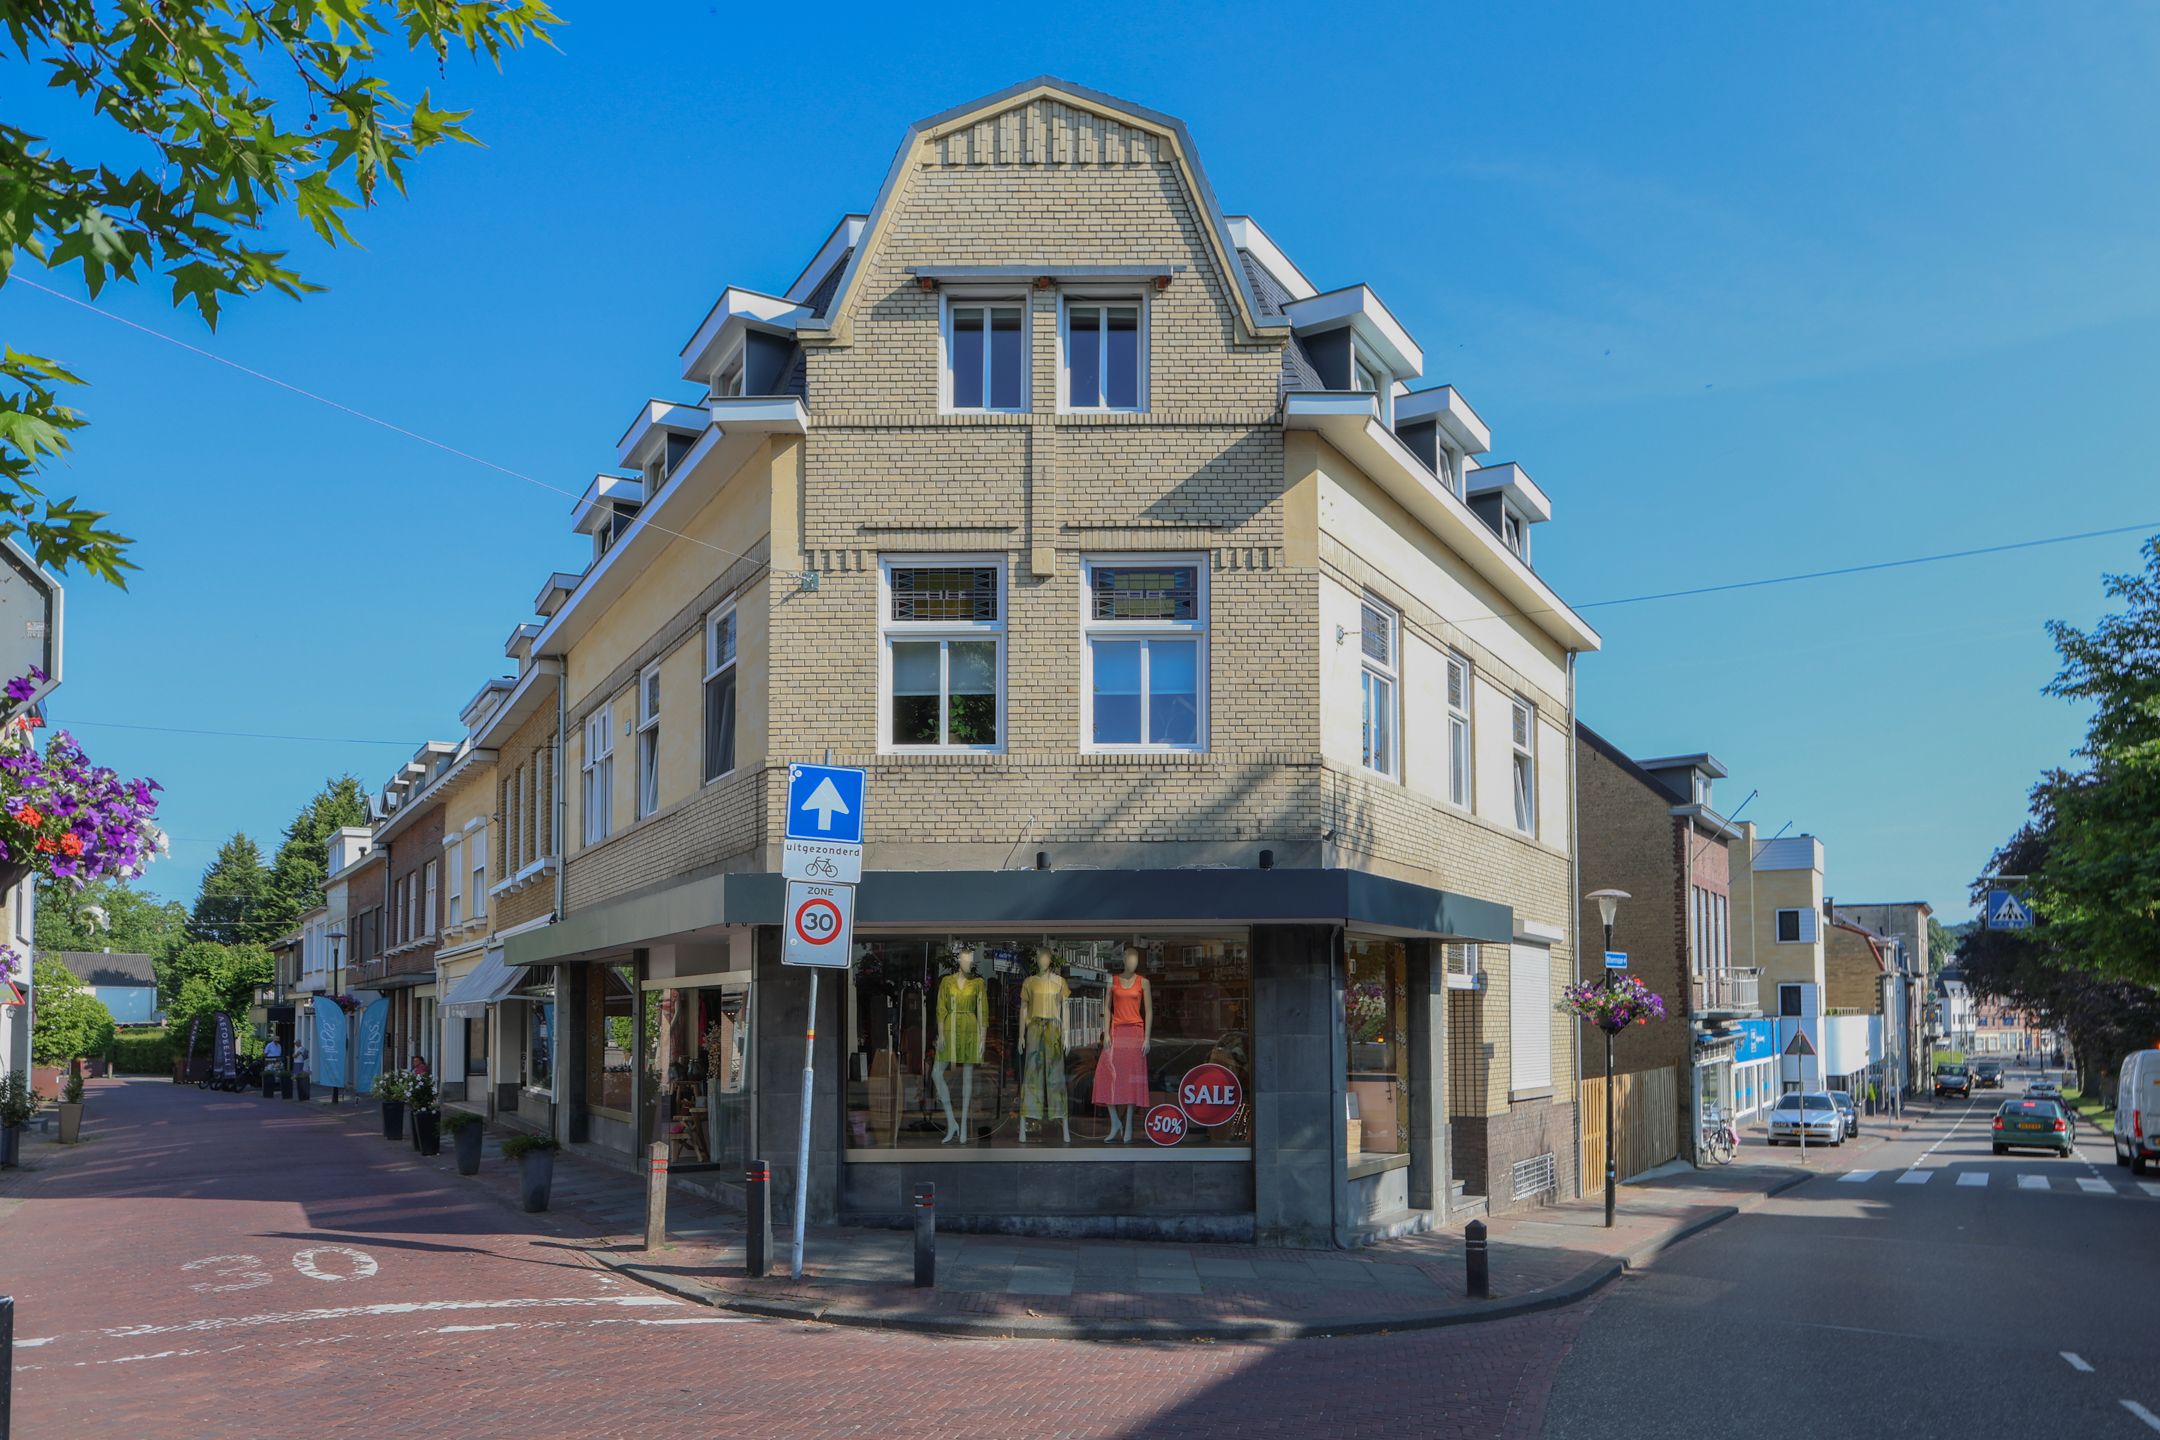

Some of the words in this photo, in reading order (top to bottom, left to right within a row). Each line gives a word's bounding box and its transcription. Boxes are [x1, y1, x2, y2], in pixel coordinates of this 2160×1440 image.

[786, 843, 860, 857] uitgezonderd
[807, 886, 834, 896] ZONE
[804, 912, 834, 932] 30
[1183, 1084, 1235, 1105] SALE
[1147, 1115, 1183, 1135] -50%
